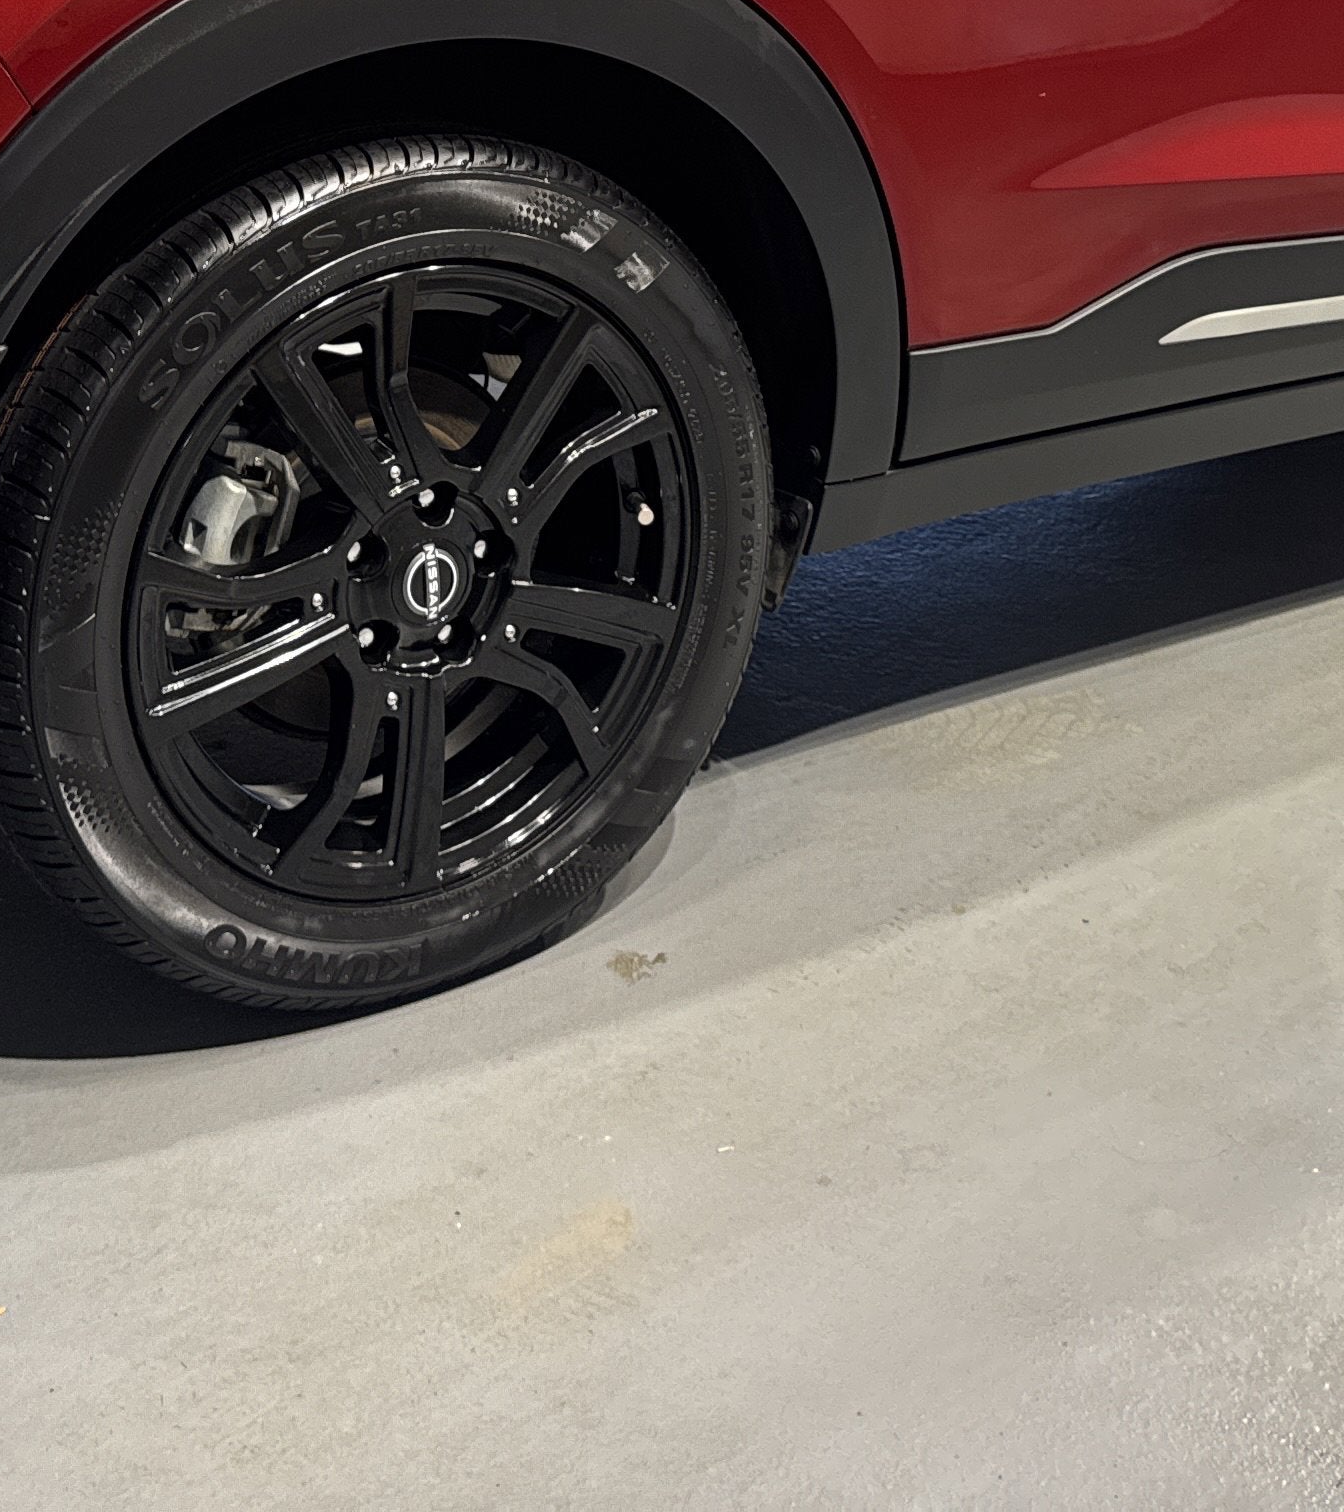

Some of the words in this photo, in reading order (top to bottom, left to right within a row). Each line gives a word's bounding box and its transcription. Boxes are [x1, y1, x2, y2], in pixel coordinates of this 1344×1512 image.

[137, 219, 346, 409] SOLUS
[355, 207, 422, 241] TA31
[422, 543, 440, 621] NISSAN
[721, 605, 747, 649] XL
[204, 923, 429, 987] KUMHO
